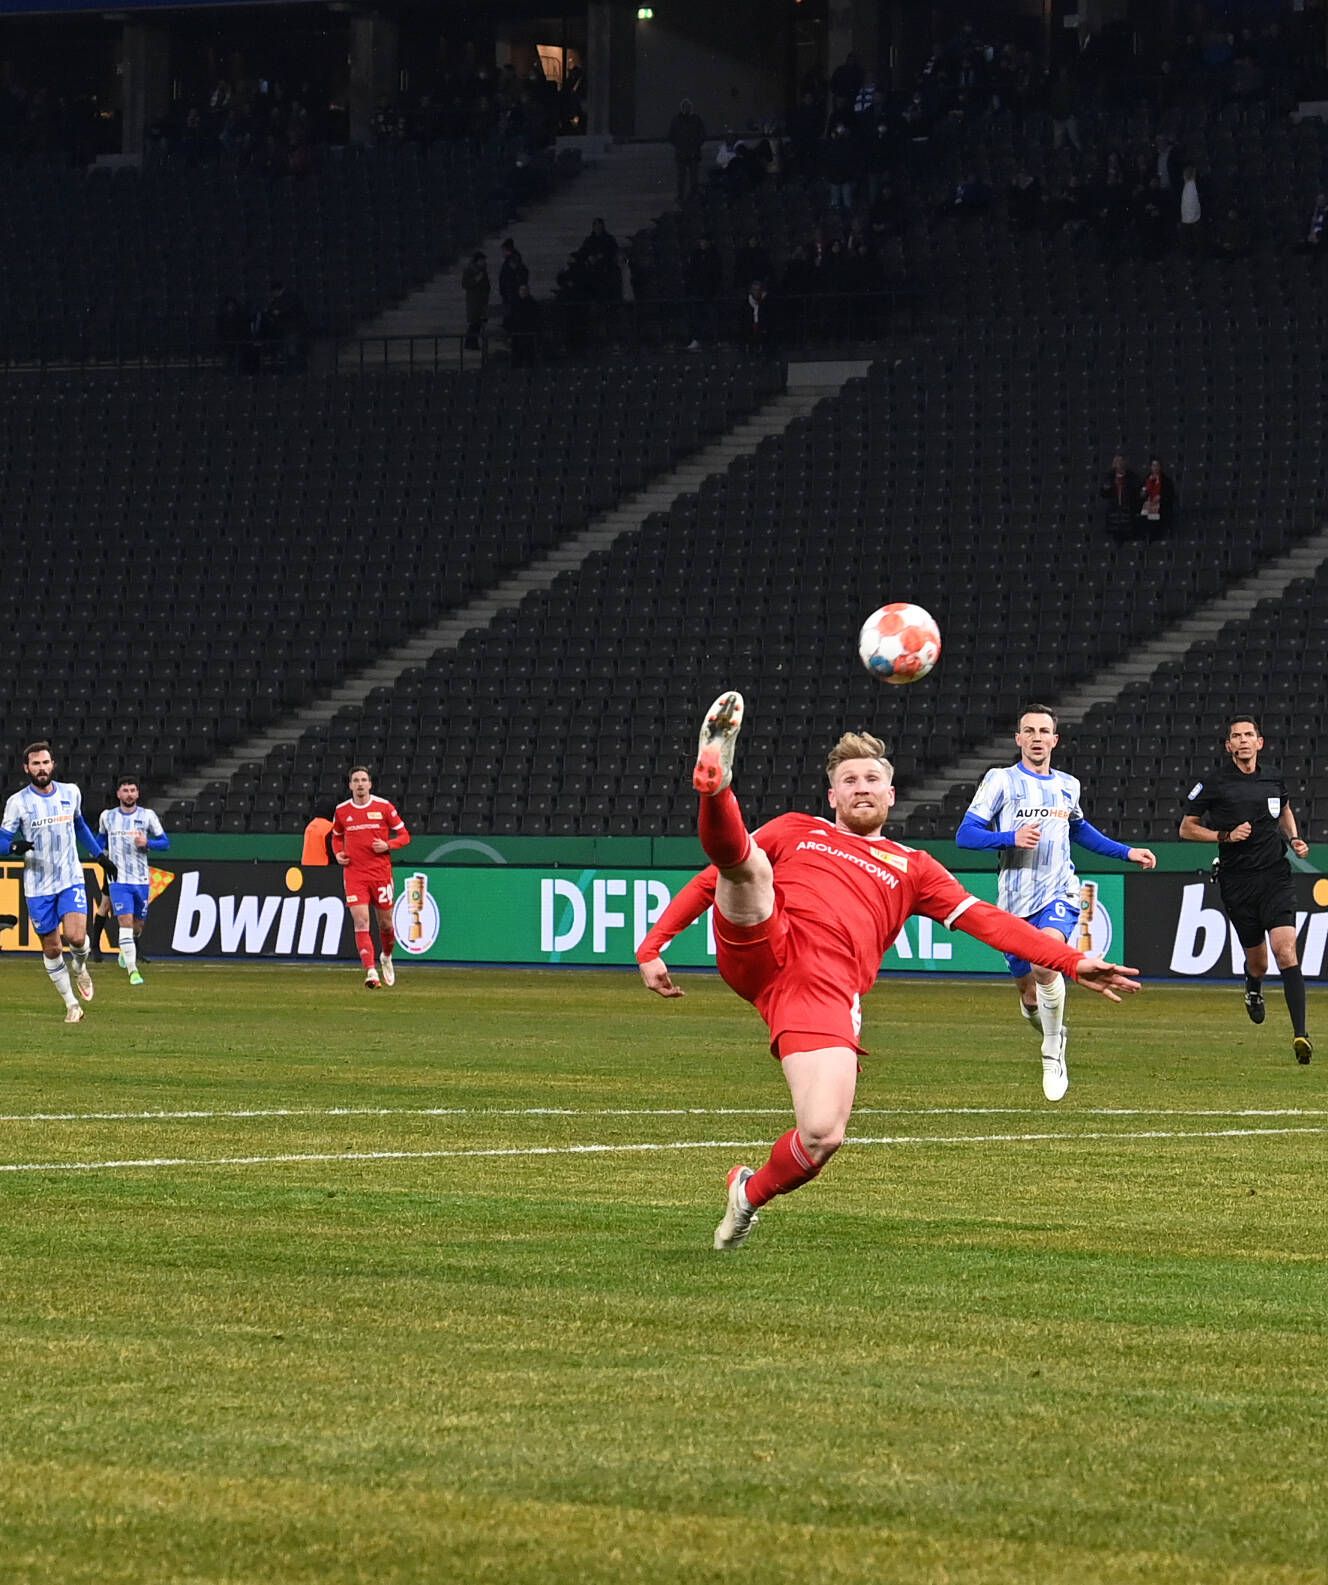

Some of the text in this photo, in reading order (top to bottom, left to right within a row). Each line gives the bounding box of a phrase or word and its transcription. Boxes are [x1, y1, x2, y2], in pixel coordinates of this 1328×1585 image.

[796, 841, 900, 889] AROUNDTOWN
[171, 866, 345, 955] bwin
[1055, 902, 1066, 918] 6
